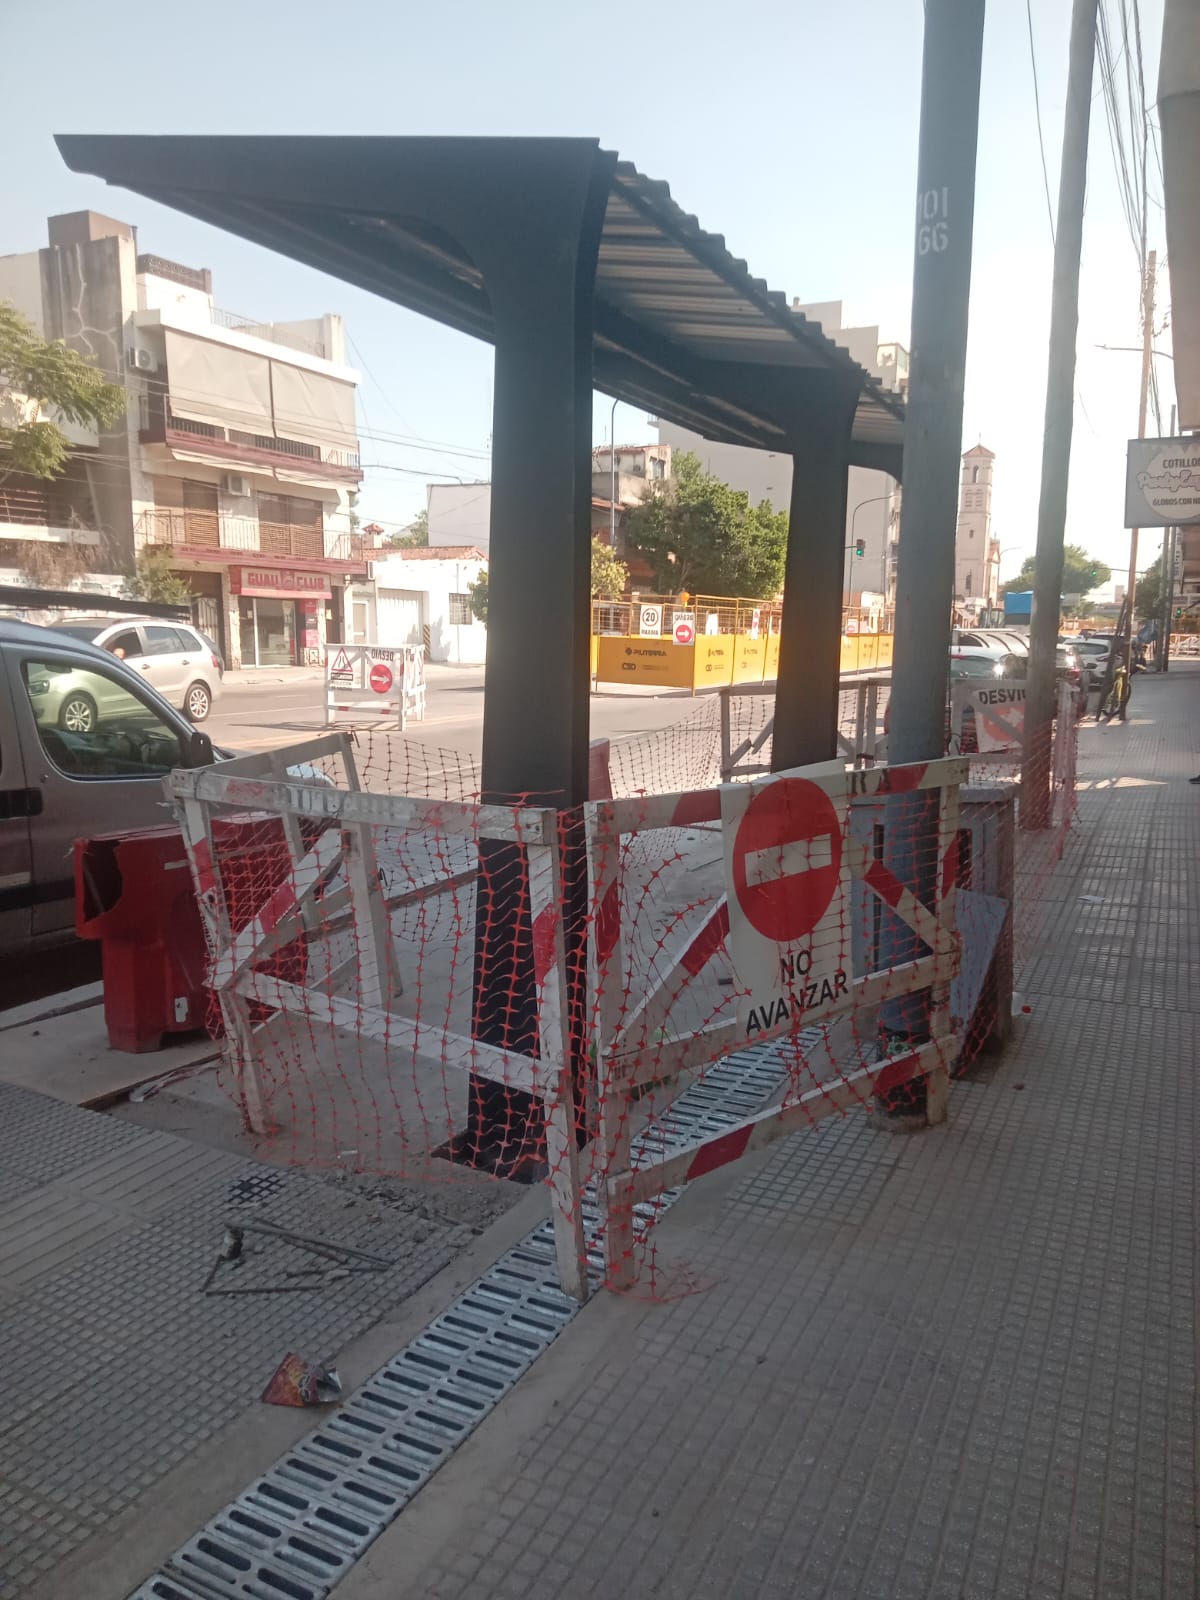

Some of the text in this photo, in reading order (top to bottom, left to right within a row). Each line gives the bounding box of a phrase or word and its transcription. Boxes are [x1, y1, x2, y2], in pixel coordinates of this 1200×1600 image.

[919, 221, 948, 256] 66
[1162, 457, 1200, 469] COTILLO
[645, 612, 656, 622] 20
[781, 950, 812, 982] NO
[746, 972, 848, 1035] AVANZAR
